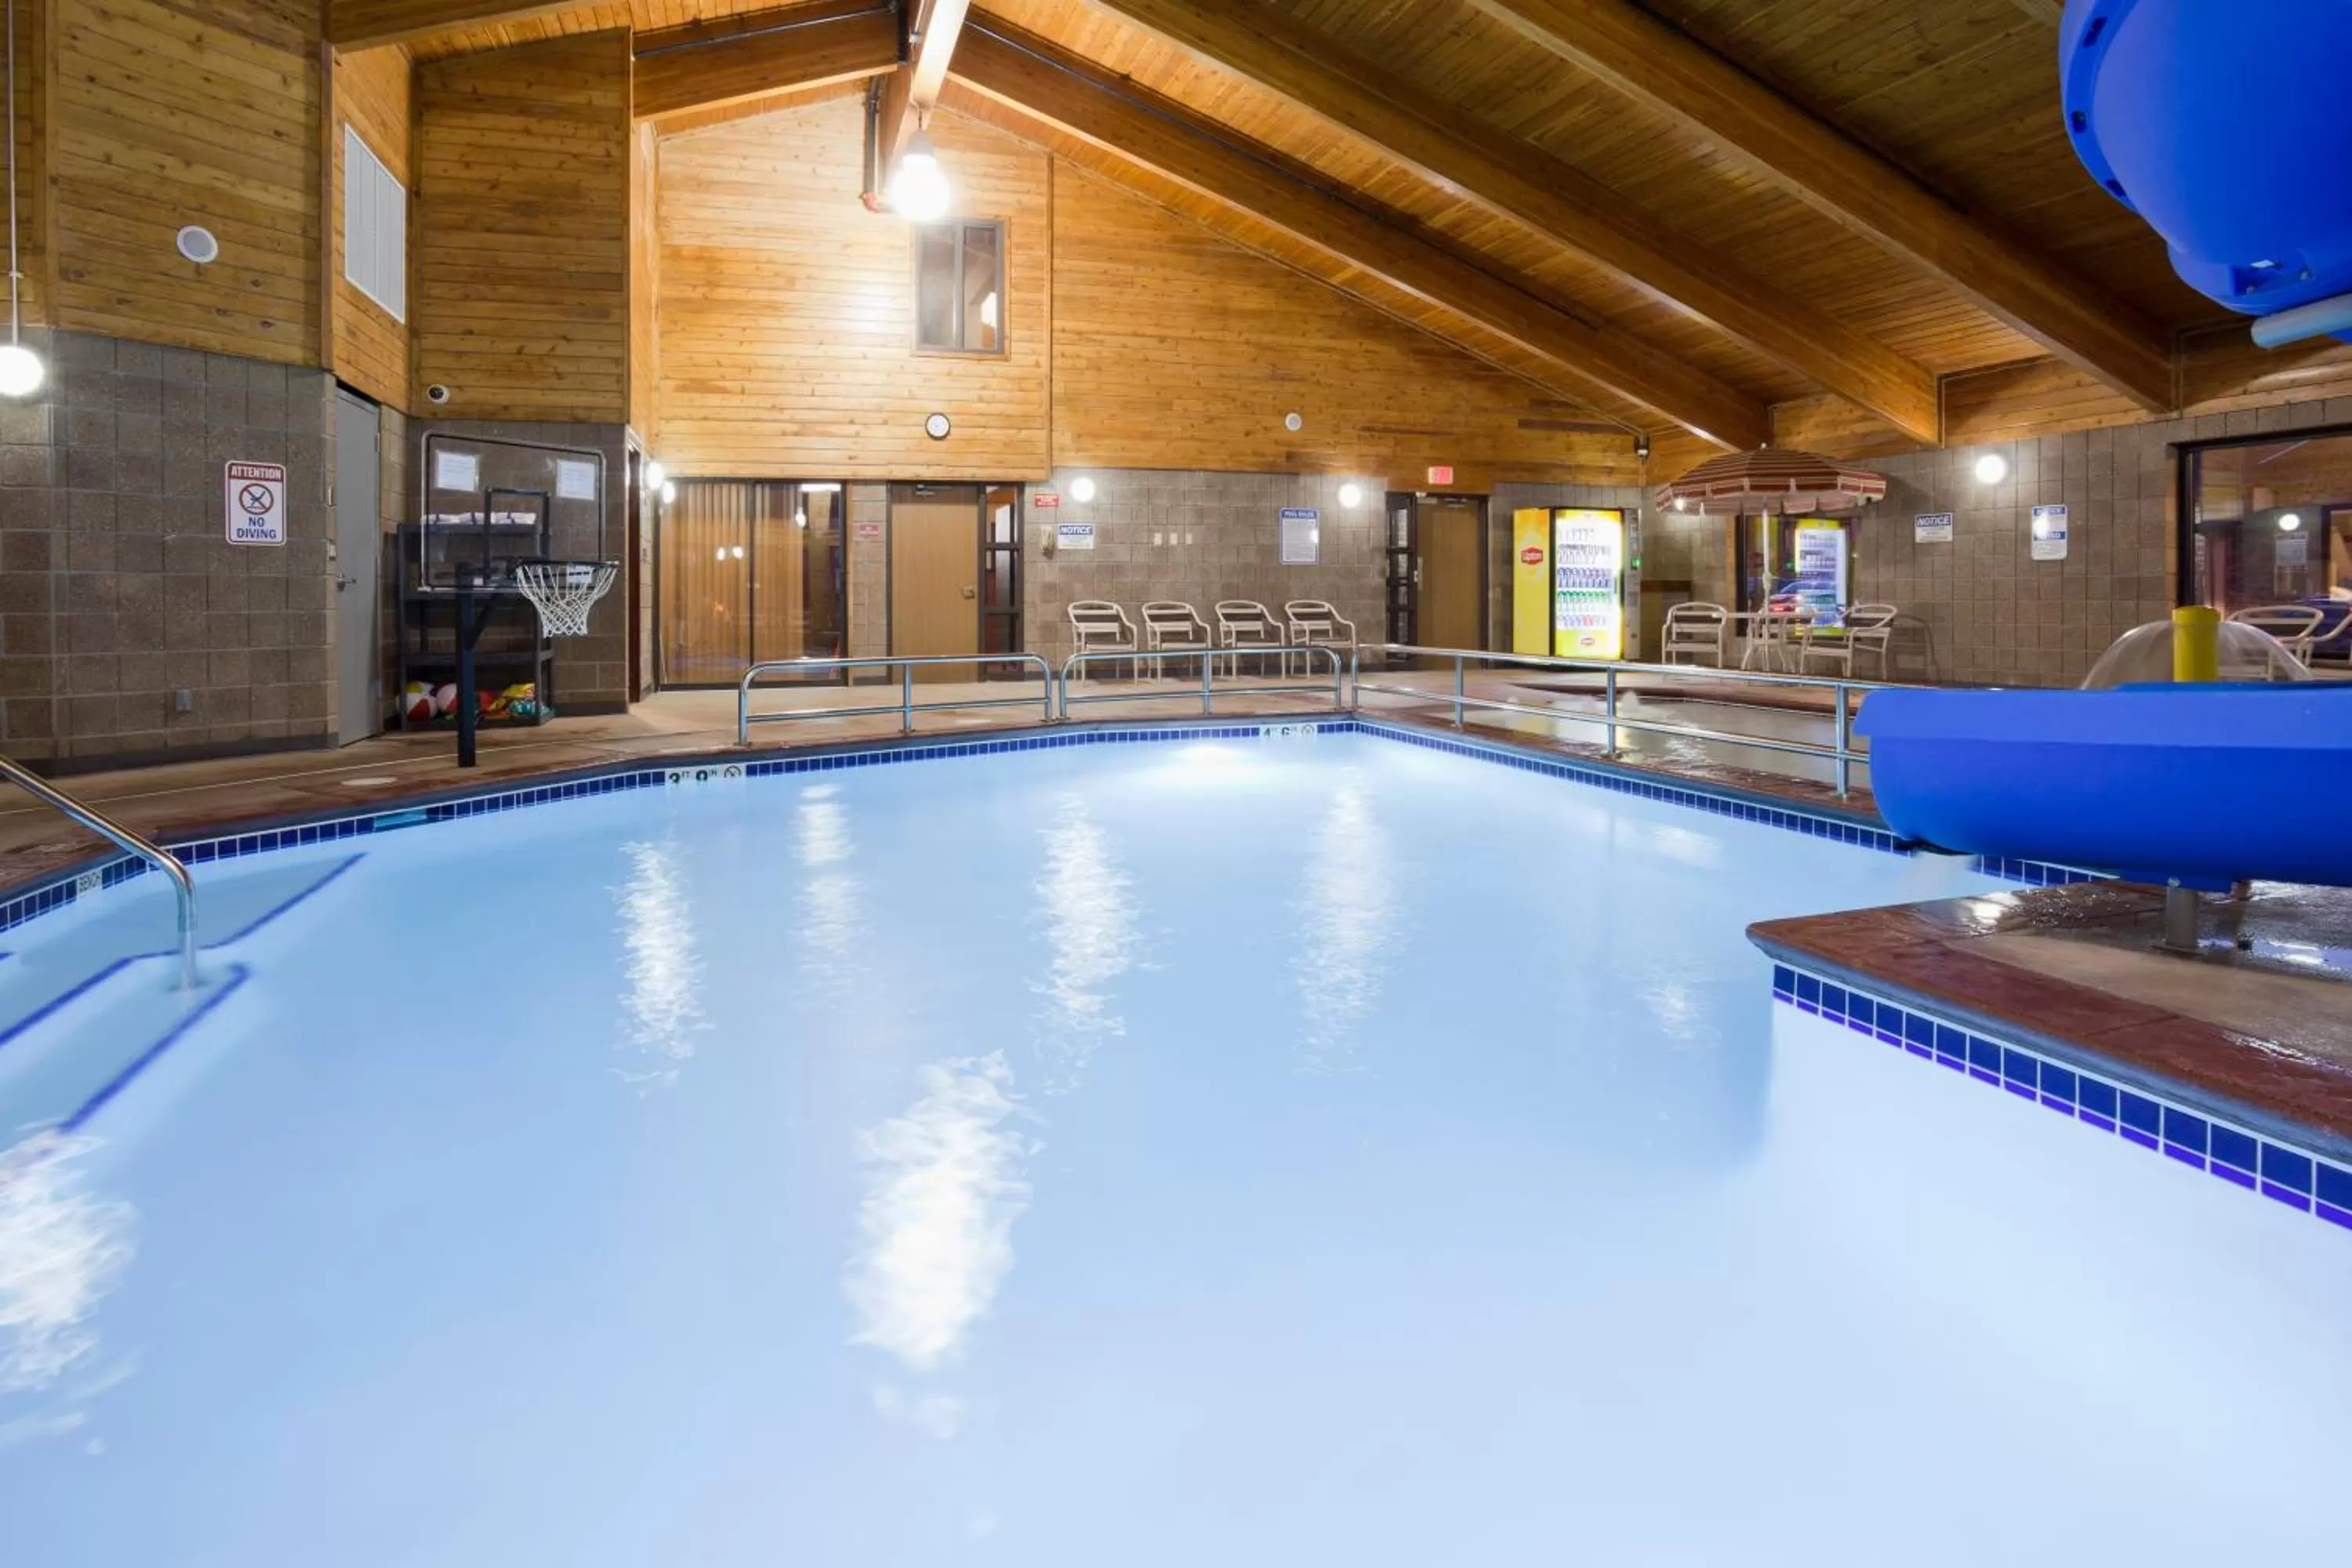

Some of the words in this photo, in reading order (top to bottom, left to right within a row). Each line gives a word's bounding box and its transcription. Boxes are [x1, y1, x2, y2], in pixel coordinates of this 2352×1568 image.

[230, 466, 281, 480] ATTENTION
[248, 517, 266, 527] NO
[1917, 517, 1951, 525] NOTICE
[237, 528, 277, 539] DIVING
